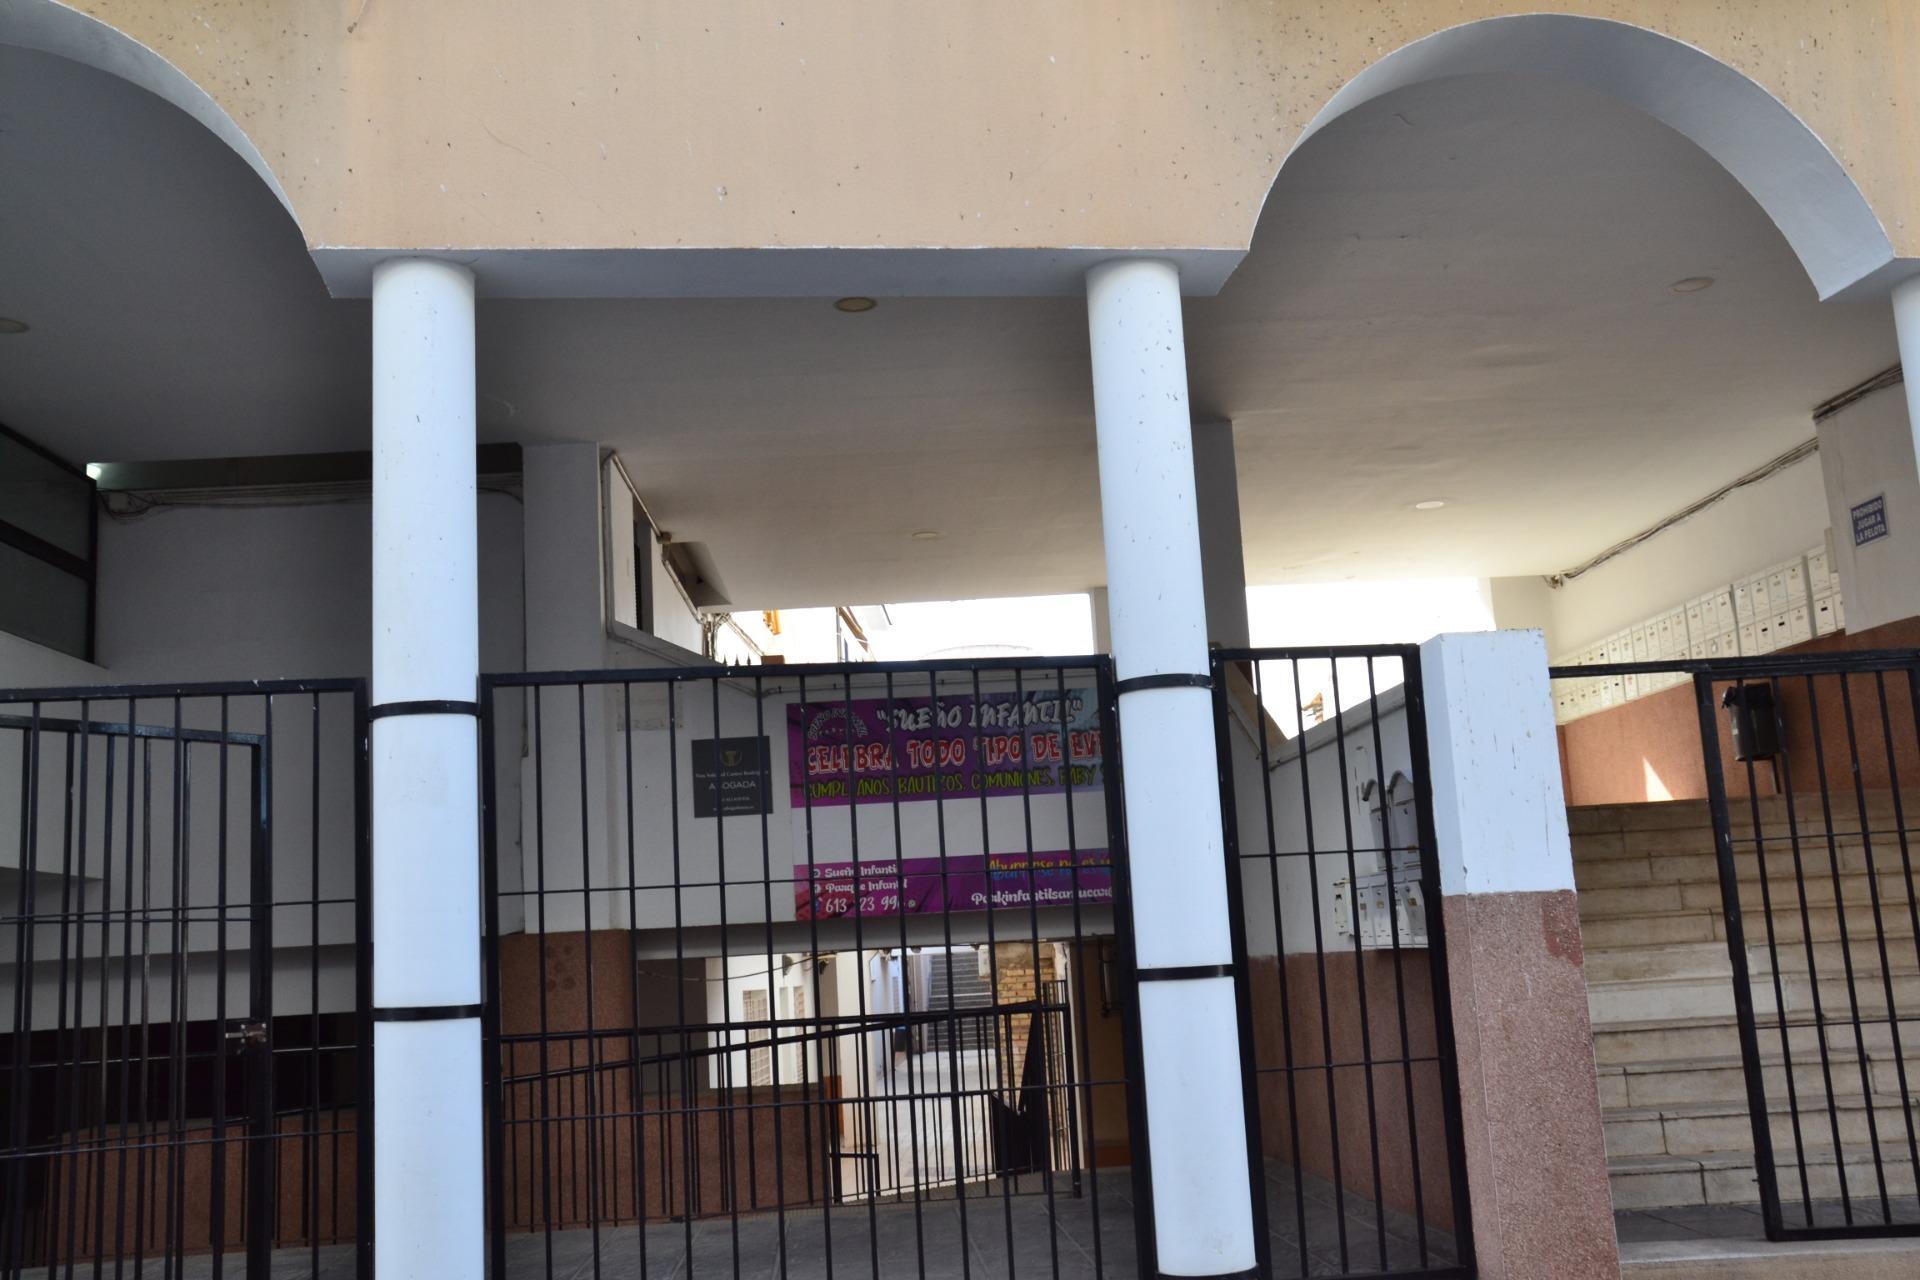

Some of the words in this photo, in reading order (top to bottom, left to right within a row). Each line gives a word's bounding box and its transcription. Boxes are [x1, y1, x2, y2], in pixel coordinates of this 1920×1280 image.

[1856, 531, 1864, 543] LA
[1864, 523, 1885, 540] PELOTA
[906, 738, 966, 769] TODO
[1032, 732, 1063, 762] DE
[708, 780, 757, 791] AOGADA
[861, 863, 900, 877] Infanti
[825, 882, 866, 895] Parqe
[825, 897, 848, 913] 613
[853, 896, 876, 912] 23
[880, 894, 906, 911] 99
